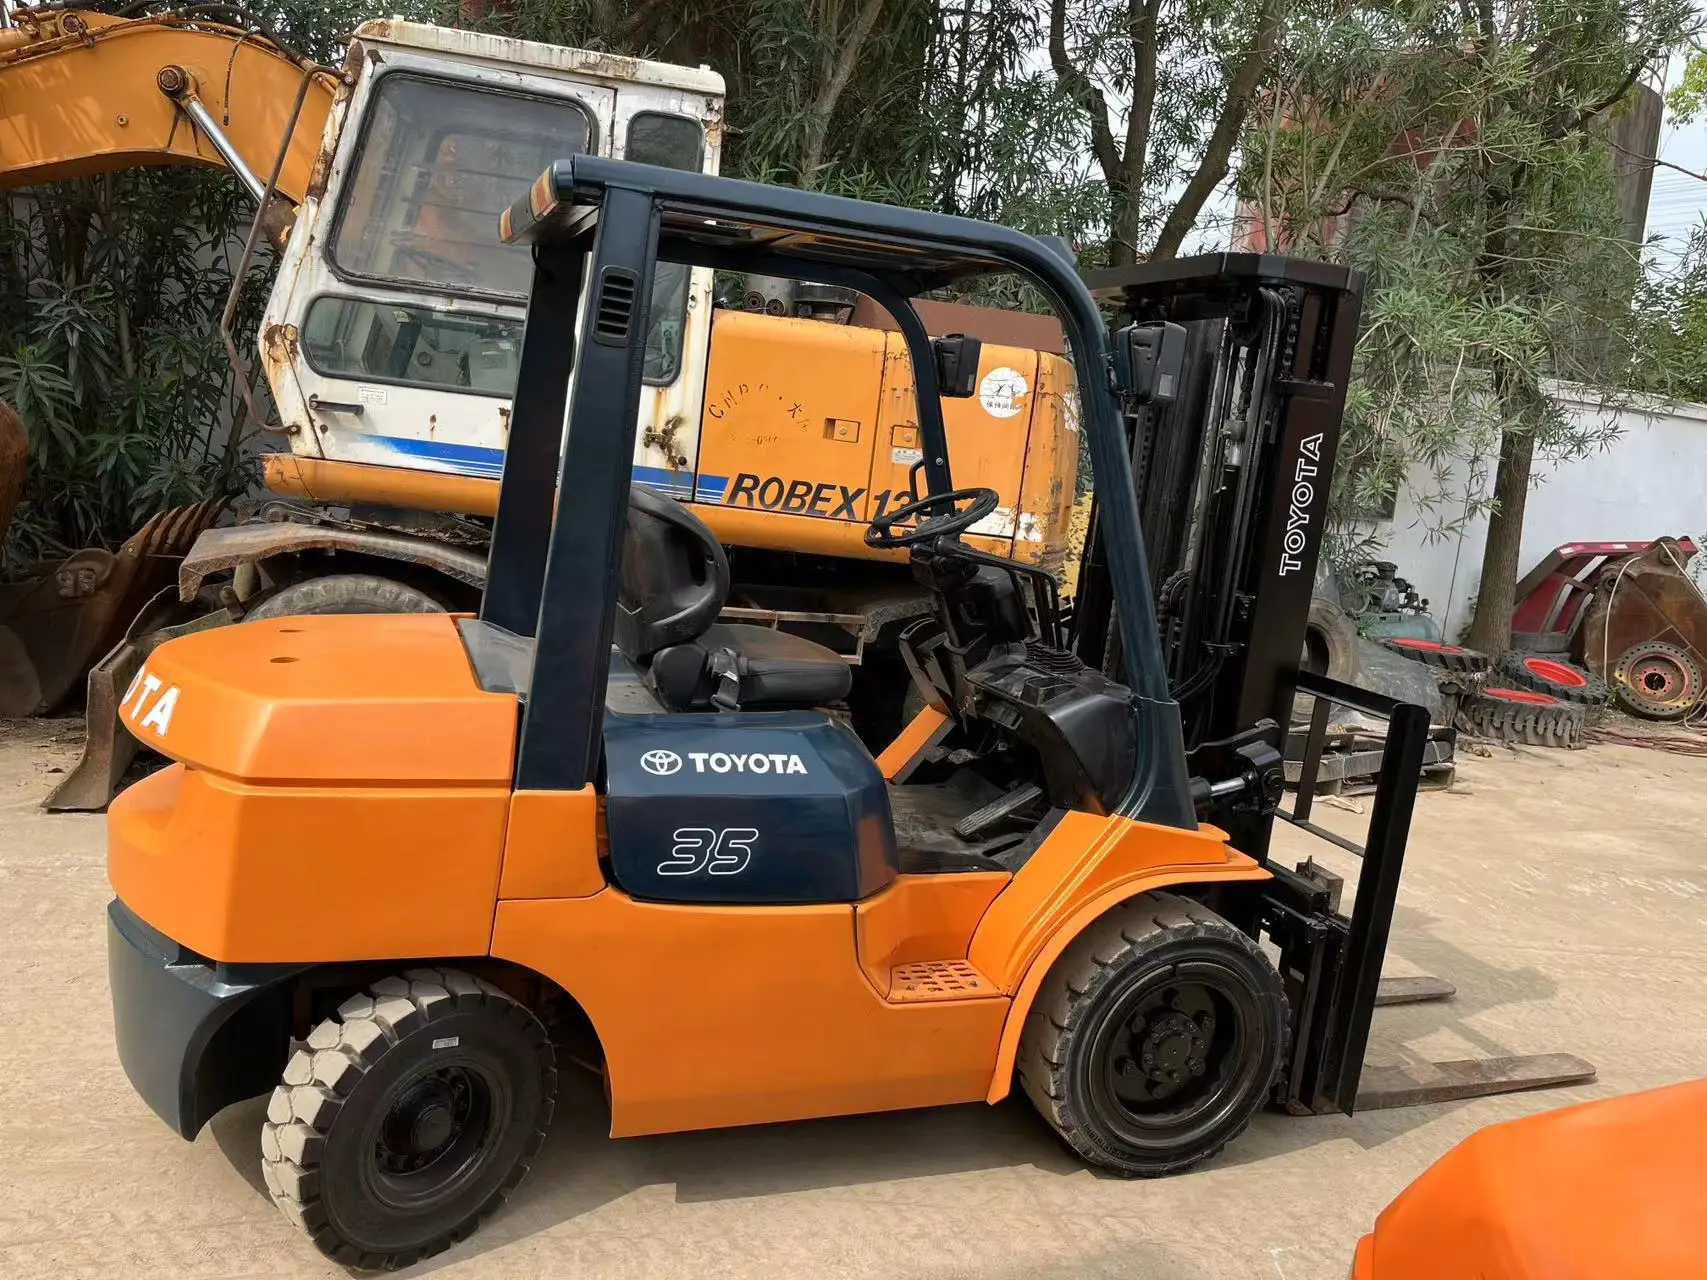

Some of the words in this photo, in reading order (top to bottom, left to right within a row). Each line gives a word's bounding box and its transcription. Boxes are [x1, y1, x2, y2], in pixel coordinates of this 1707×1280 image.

[727, 473, 866, 521] ROBEX
[1279, 433, 1323, 576] TOYOTA
[688, 752, 808, 775] TOYOTA
[657, 827, 759, 875] 35
